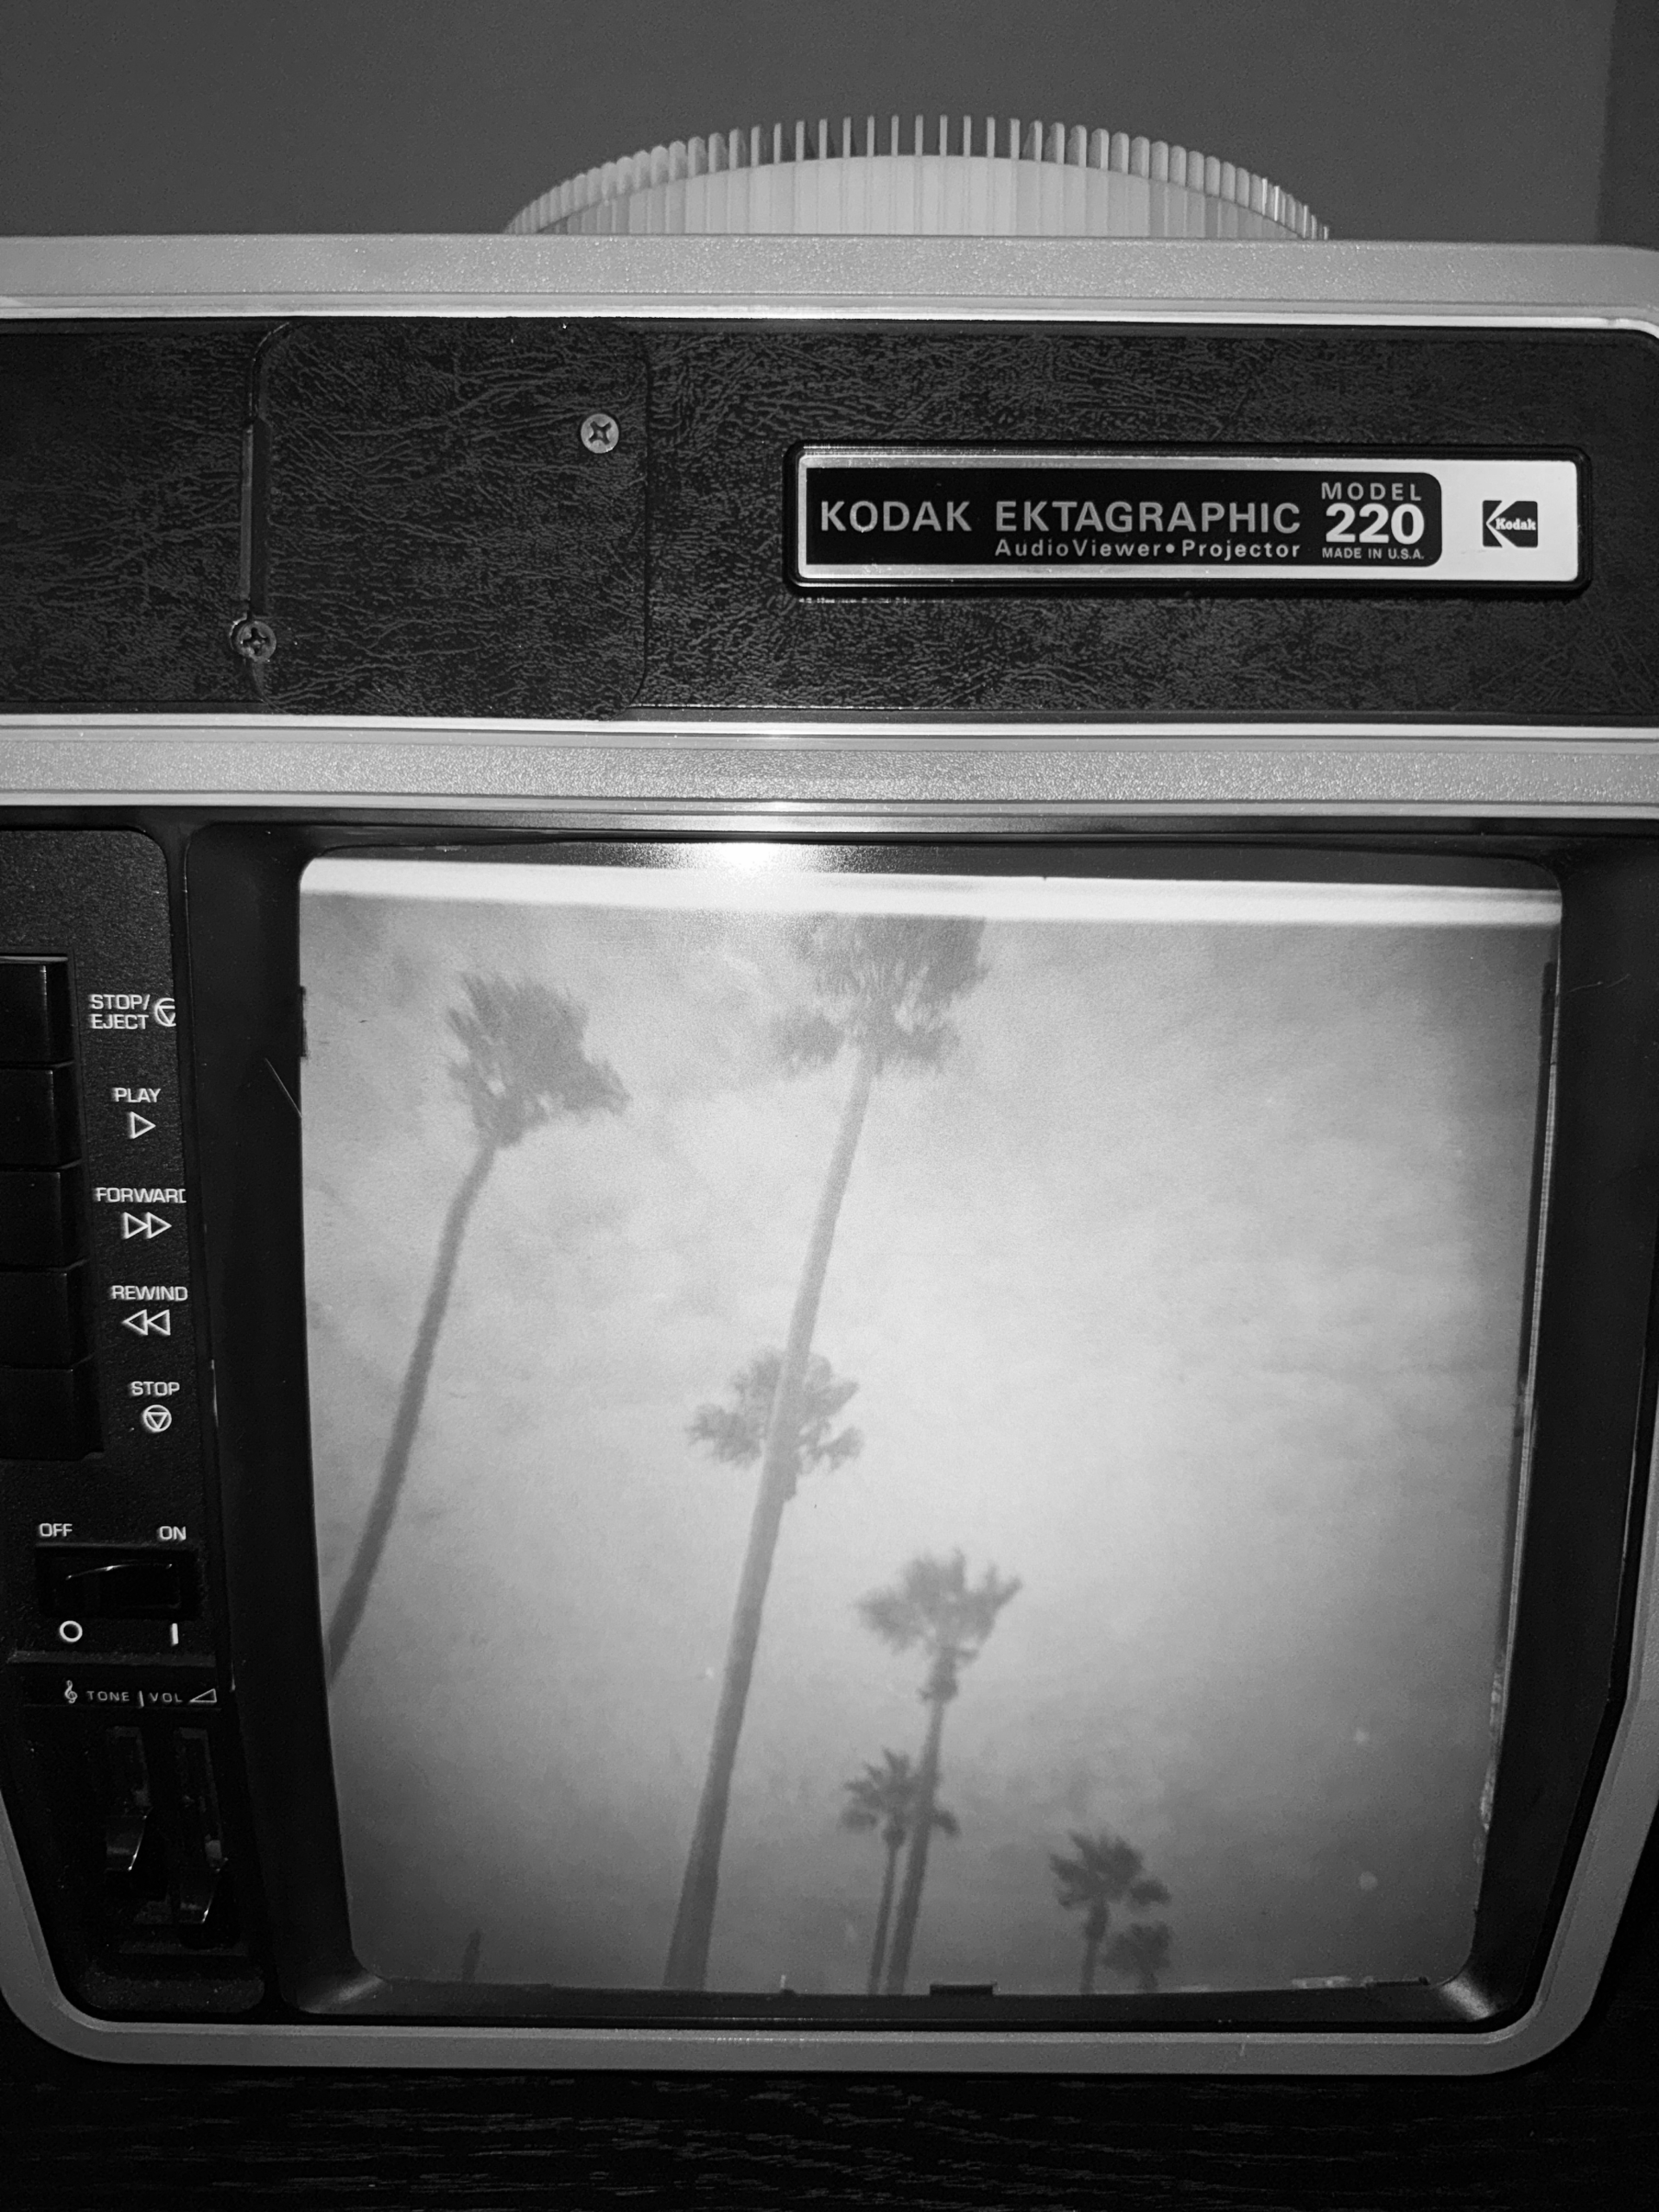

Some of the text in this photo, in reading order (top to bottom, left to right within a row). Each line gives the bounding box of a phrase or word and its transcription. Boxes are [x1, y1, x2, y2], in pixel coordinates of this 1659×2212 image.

[1322, 482, 1422, 501] MODEL
[822, 501, 1300, 533] KODAK EKTAGRAPHIC
[1326, 504, 1425, 544] 220
[1495, 518, 1536, 531] Kodak
[1322, 547, 1425, 560] MADE IN U.S.A.
[90, 994, 151, 1010] STOP/
[90, 1014, 149, 1029] EJECT
[112, 1088, 162, 1103] PLAY
[111, 1285, 188, 1301] REWIND
[130, 1381, 181, 1396] STOP
[39, 1523, 187, 1541] OFF ON
[86, 1691, 183, 1703] TONE VOL
